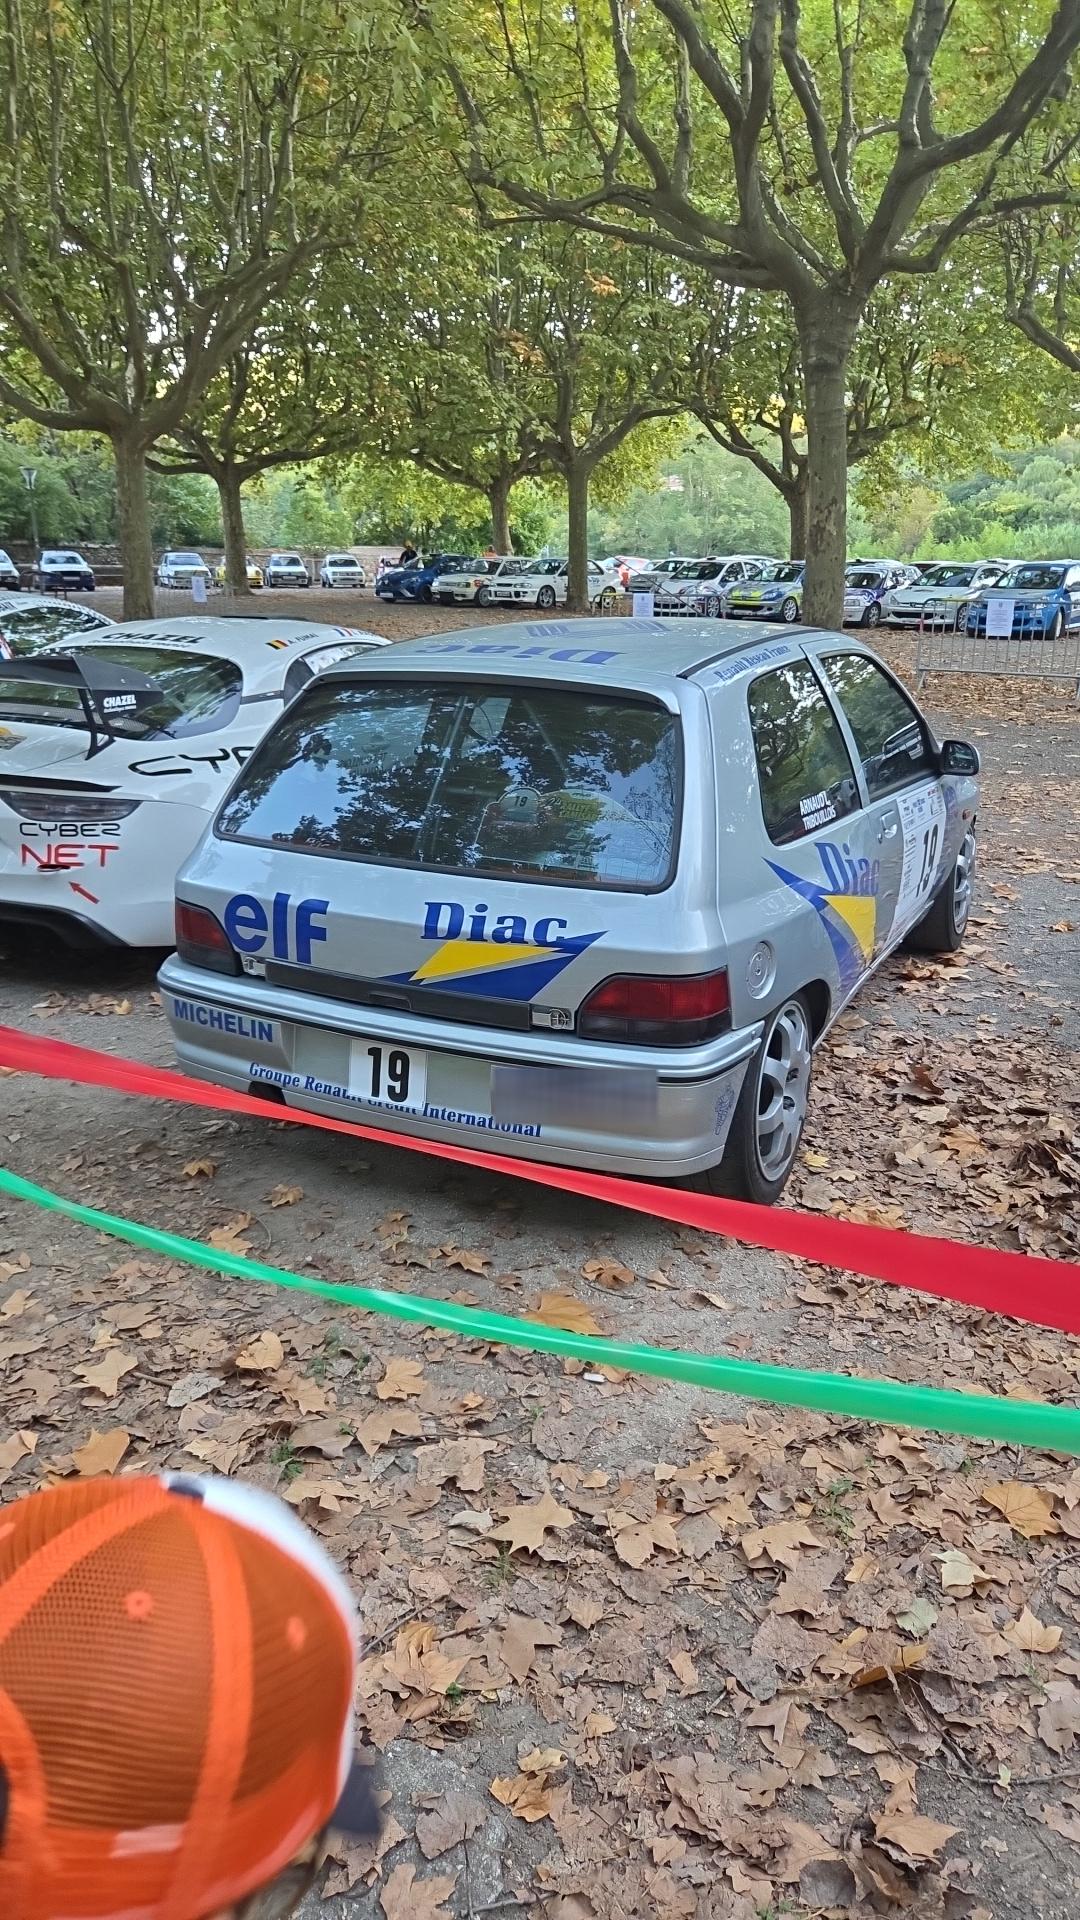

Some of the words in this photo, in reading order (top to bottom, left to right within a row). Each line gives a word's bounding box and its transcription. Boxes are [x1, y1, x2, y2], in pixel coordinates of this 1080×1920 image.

[102, 632, 206, 645] CHAZEL
[103, 694, 137, 708] CHAZEL
[514, 795, 528, 807] 19
[20, 822, 121, 837] CYBER
[21, 843, 120, 867] NET
[813, 841, 881, 896] Diac
[916, 824, 940, 898] 19
[224, 892, 330, 965] elf
[421, 901, 568, 947] Diac
[173, 999, 274, 1043] MICHELIN
[249, 1062, 301, 1090] Groupe
[304, 1075, 362, 1103] Renau
[367, 1046, 410, 1103] 19
